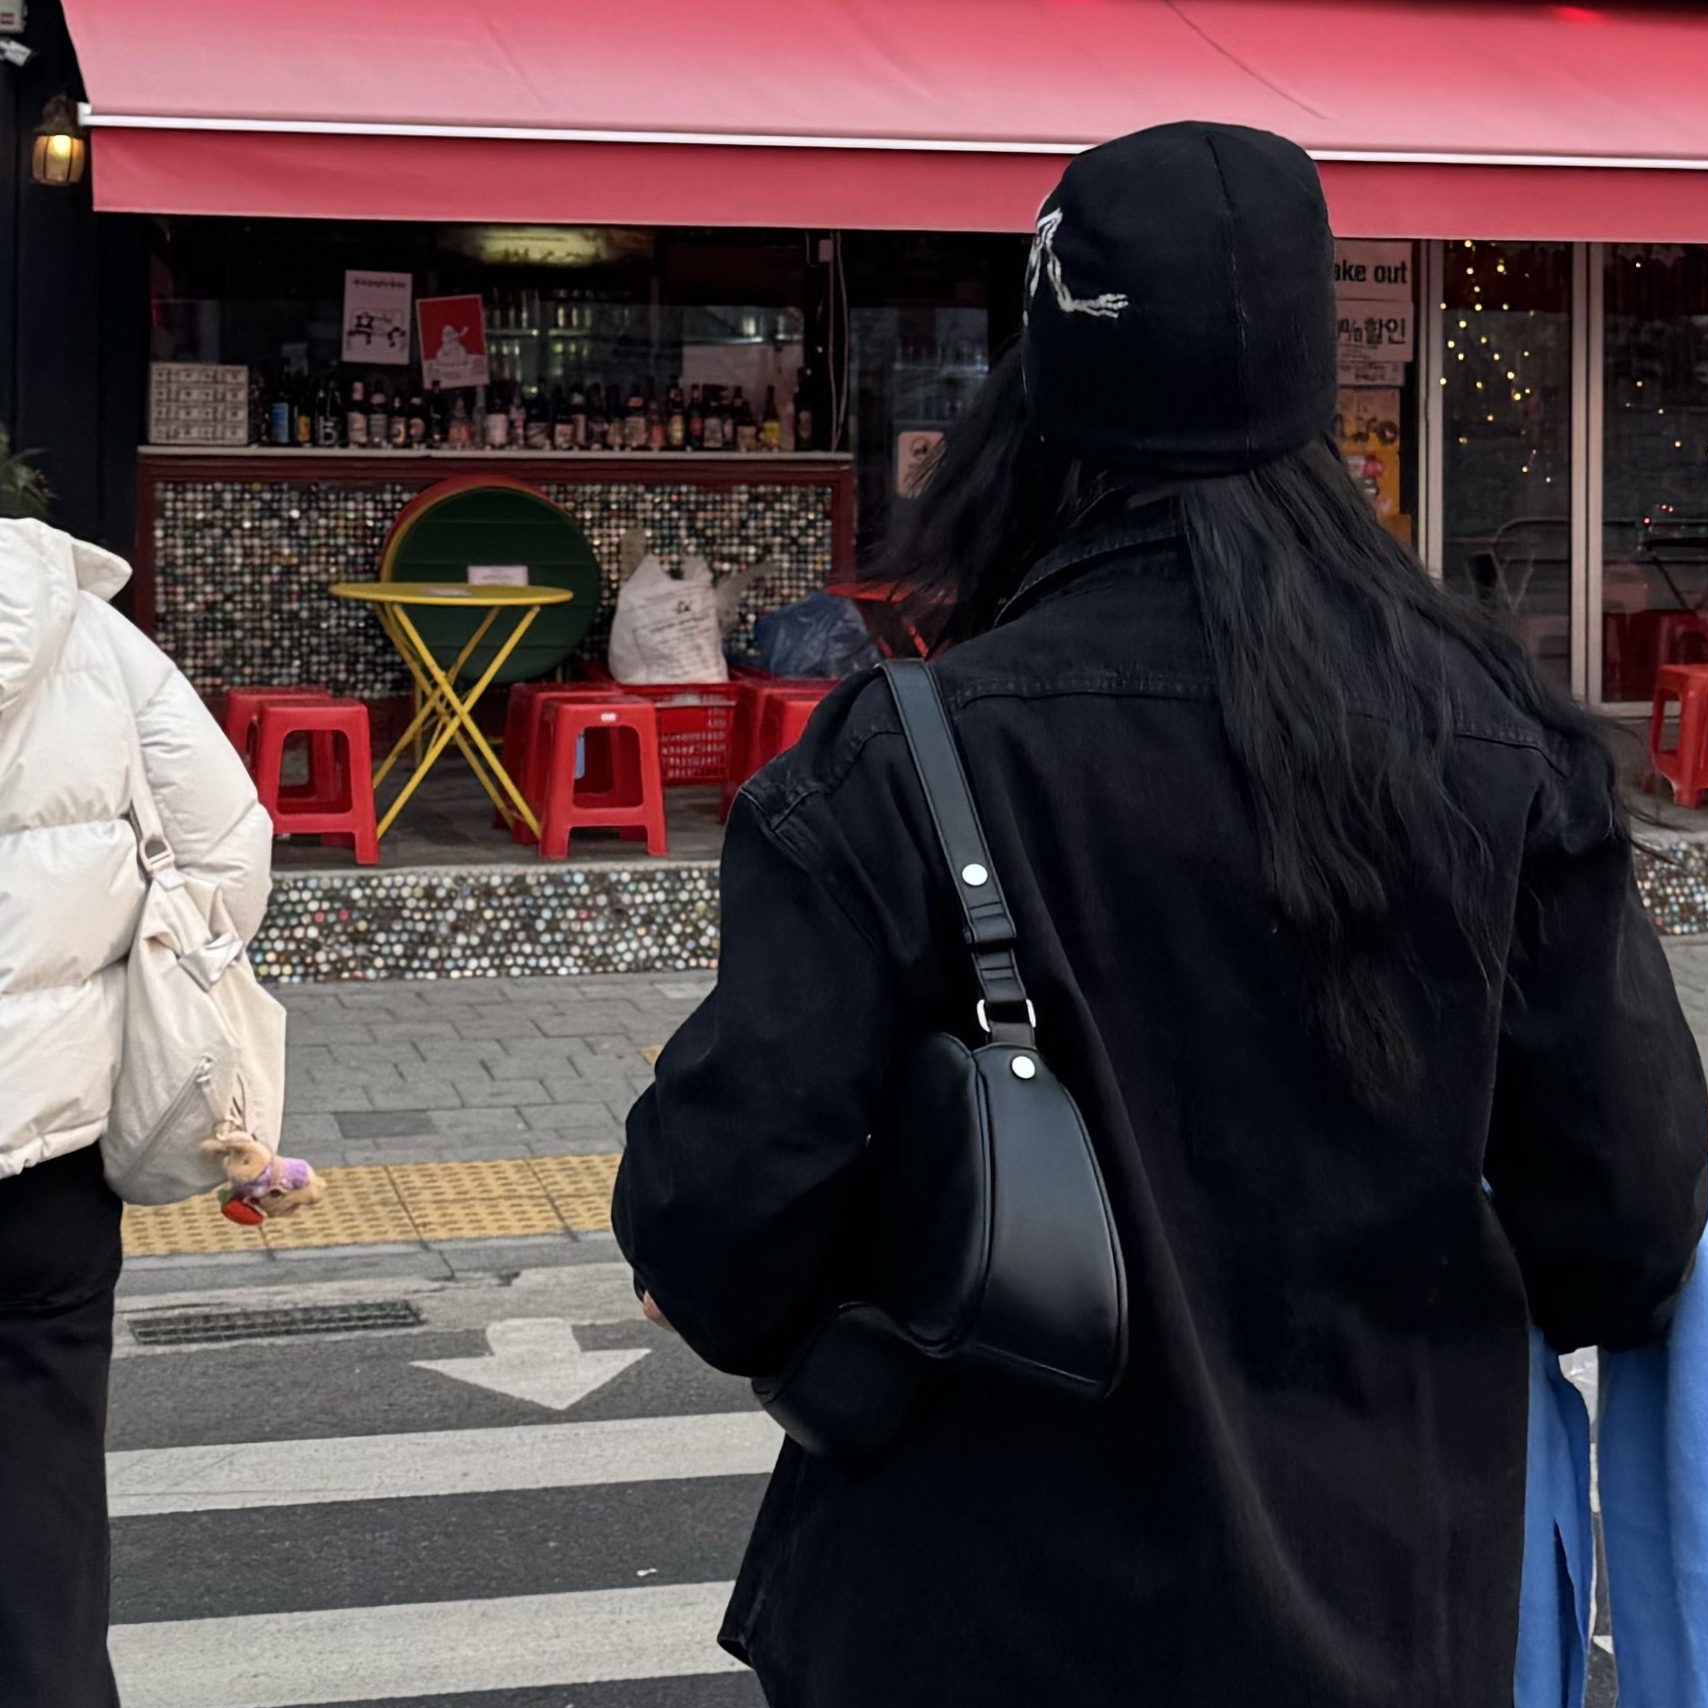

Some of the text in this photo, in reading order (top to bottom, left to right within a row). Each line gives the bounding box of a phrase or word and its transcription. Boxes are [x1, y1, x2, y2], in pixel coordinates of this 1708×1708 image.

[1335, 259, 1407, 284] ake out
[1337, 318, 1406, 345] %할인
